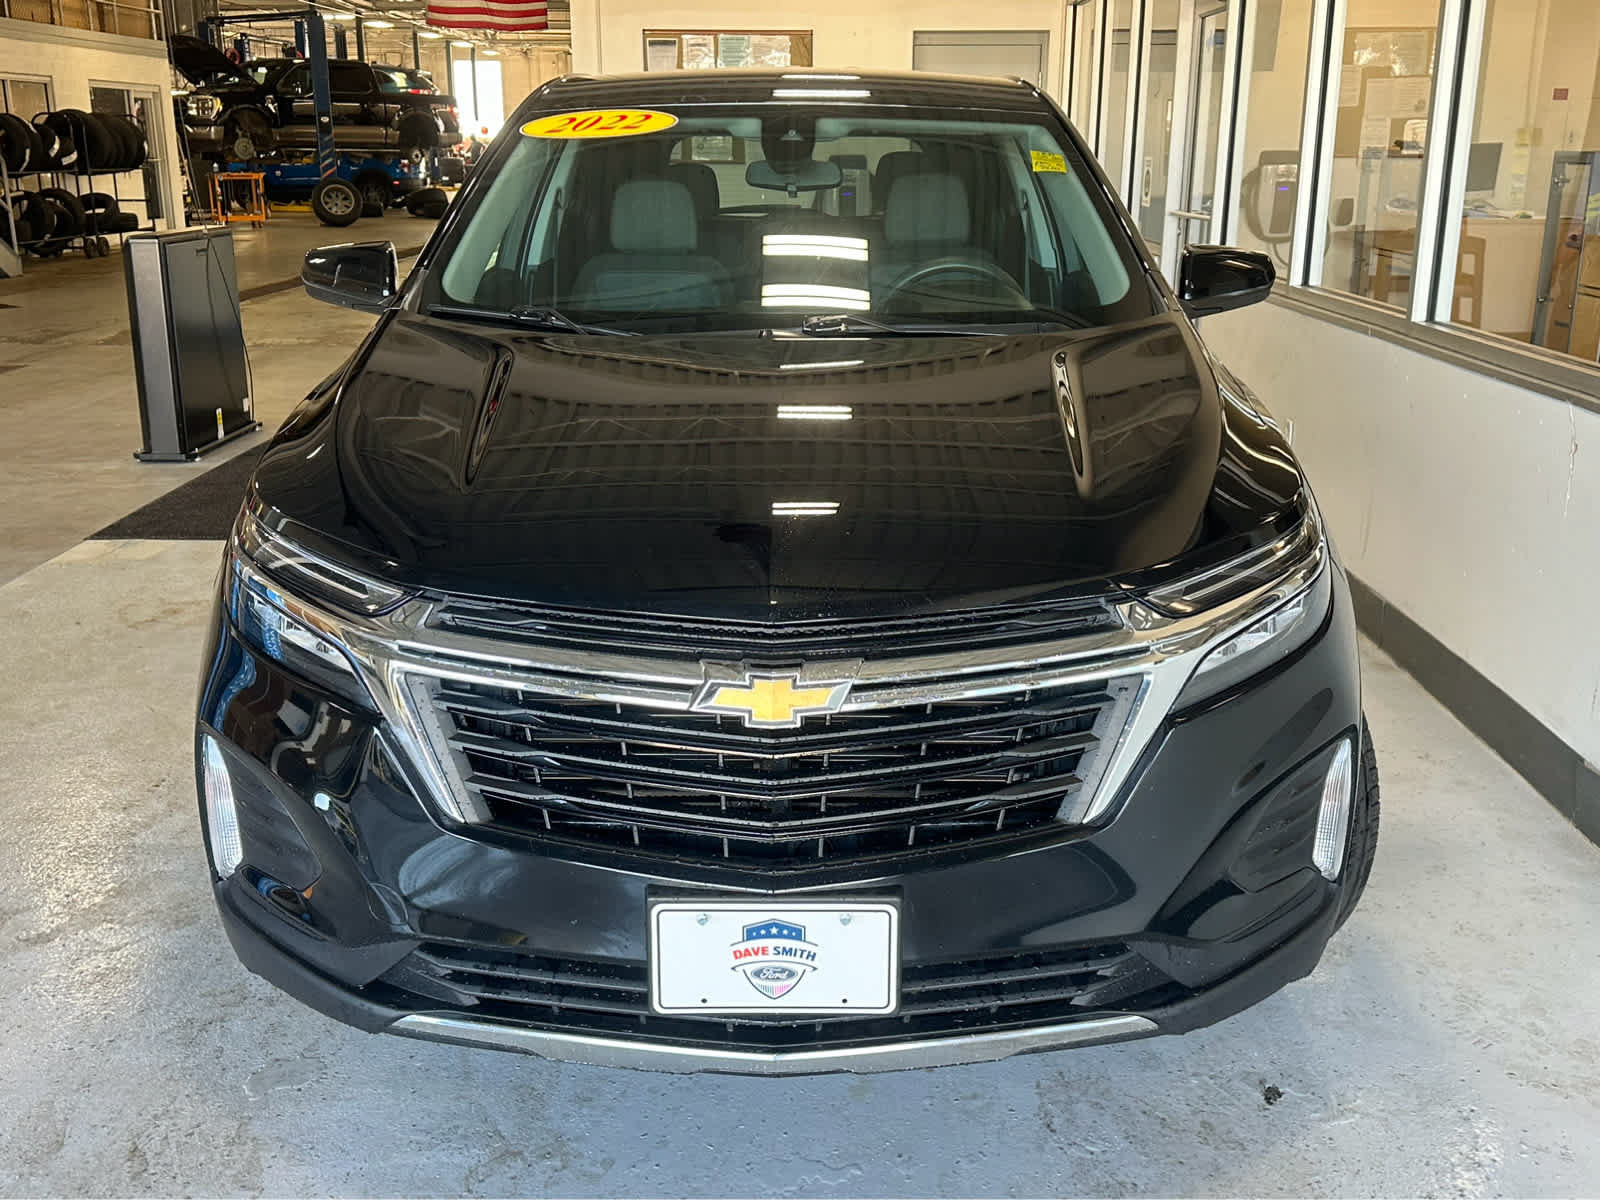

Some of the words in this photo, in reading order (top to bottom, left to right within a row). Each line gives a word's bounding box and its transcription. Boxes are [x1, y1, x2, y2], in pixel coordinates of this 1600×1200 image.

[544, 114, 653, 133] 2022
[732, 946, 769, 960] DAVE
[772, 946, 816, 961] SMITH
[759, 967, 790, 980] Ford
